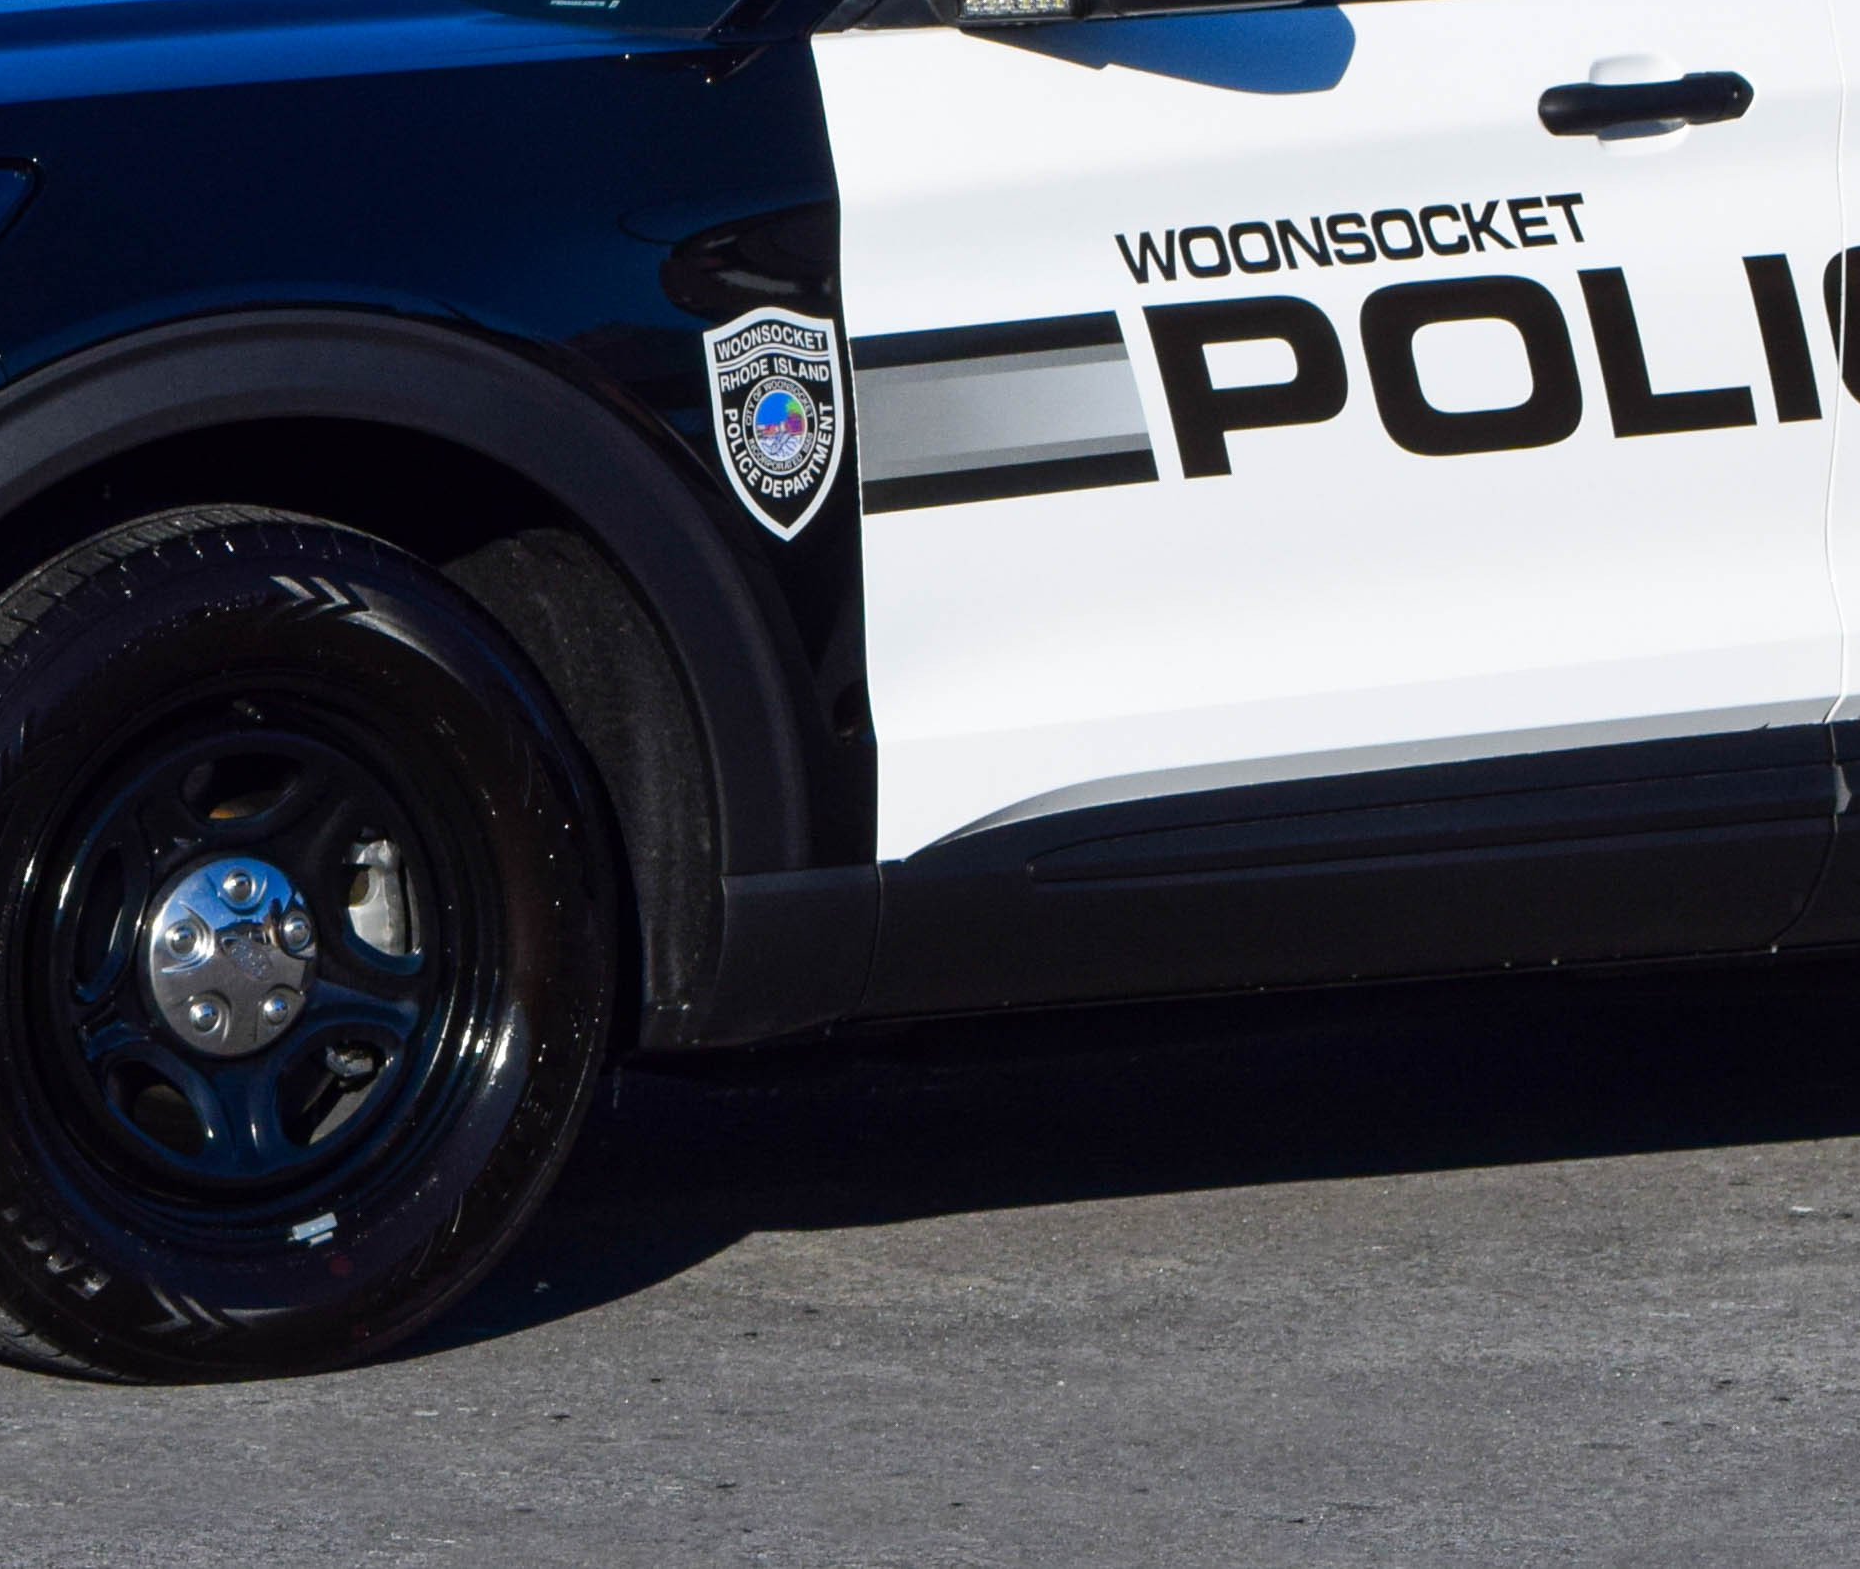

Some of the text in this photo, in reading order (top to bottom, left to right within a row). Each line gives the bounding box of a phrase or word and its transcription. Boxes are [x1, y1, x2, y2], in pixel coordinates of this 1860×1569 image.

[1116, 193, 1586, 284] WOONSOCKET
[716, 324, 824, 361] WOONSOCKET
[720, 356, 830, 393] RHODE ISLAND
[763, 381, 814, 418] WOONSOCKET
[724, 402, 833, 499] POLICE DEPARTMENT
